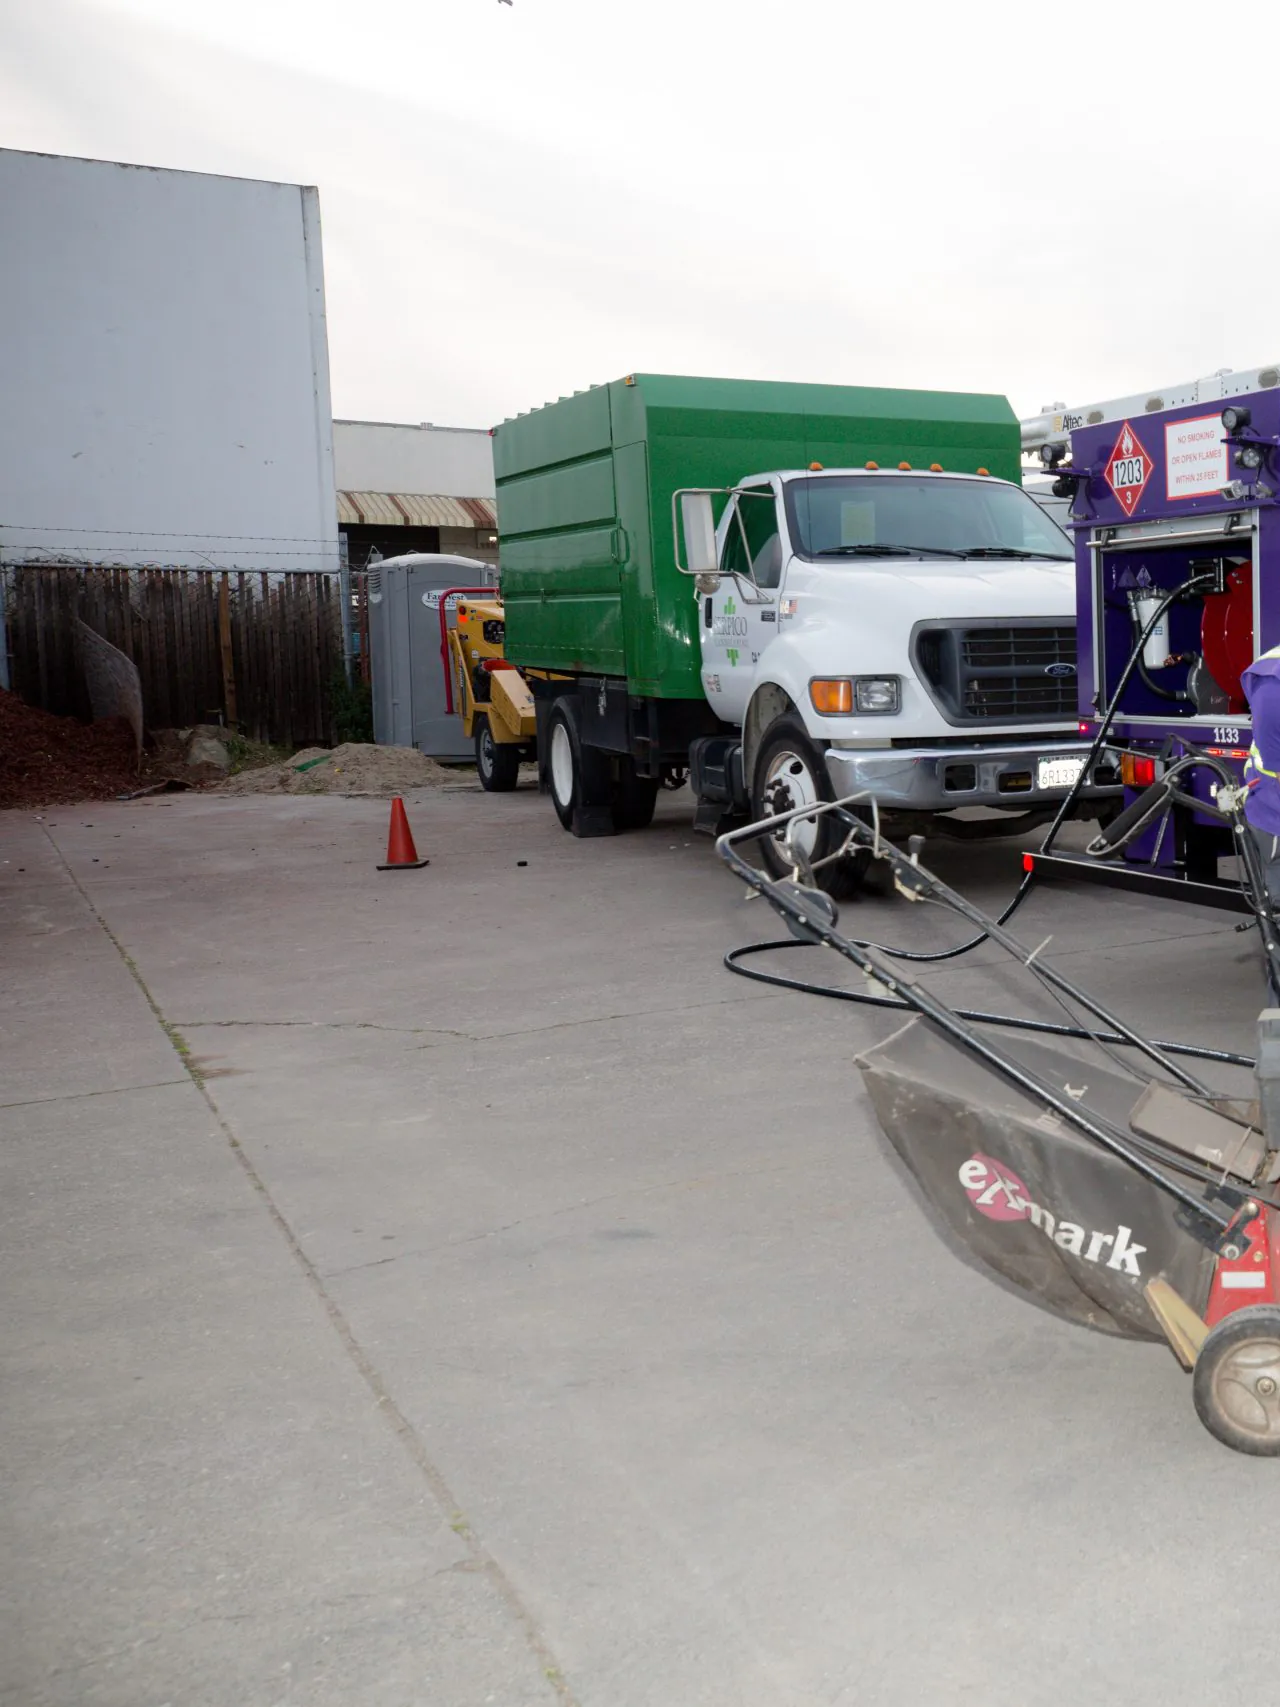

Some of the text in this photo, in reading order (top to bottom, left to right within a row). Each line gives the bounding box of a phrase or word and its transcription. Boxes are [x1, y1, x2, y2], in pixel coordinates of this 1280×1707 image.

[1062, 415, 1083, 430] Altec
[1177, 430, 1215, 443] NO SMOKING
[1171, 449, 1222, 465] OR OPEN FLAMES
[1114, 459, 1142, 486] 1203
[1175, 474, 1195, 484] WITHIN
[1203, 470, 1218, 479] FEET
[1126, 491, 1132, 504] 3
[1213, 727, 1240, 744] 1133
